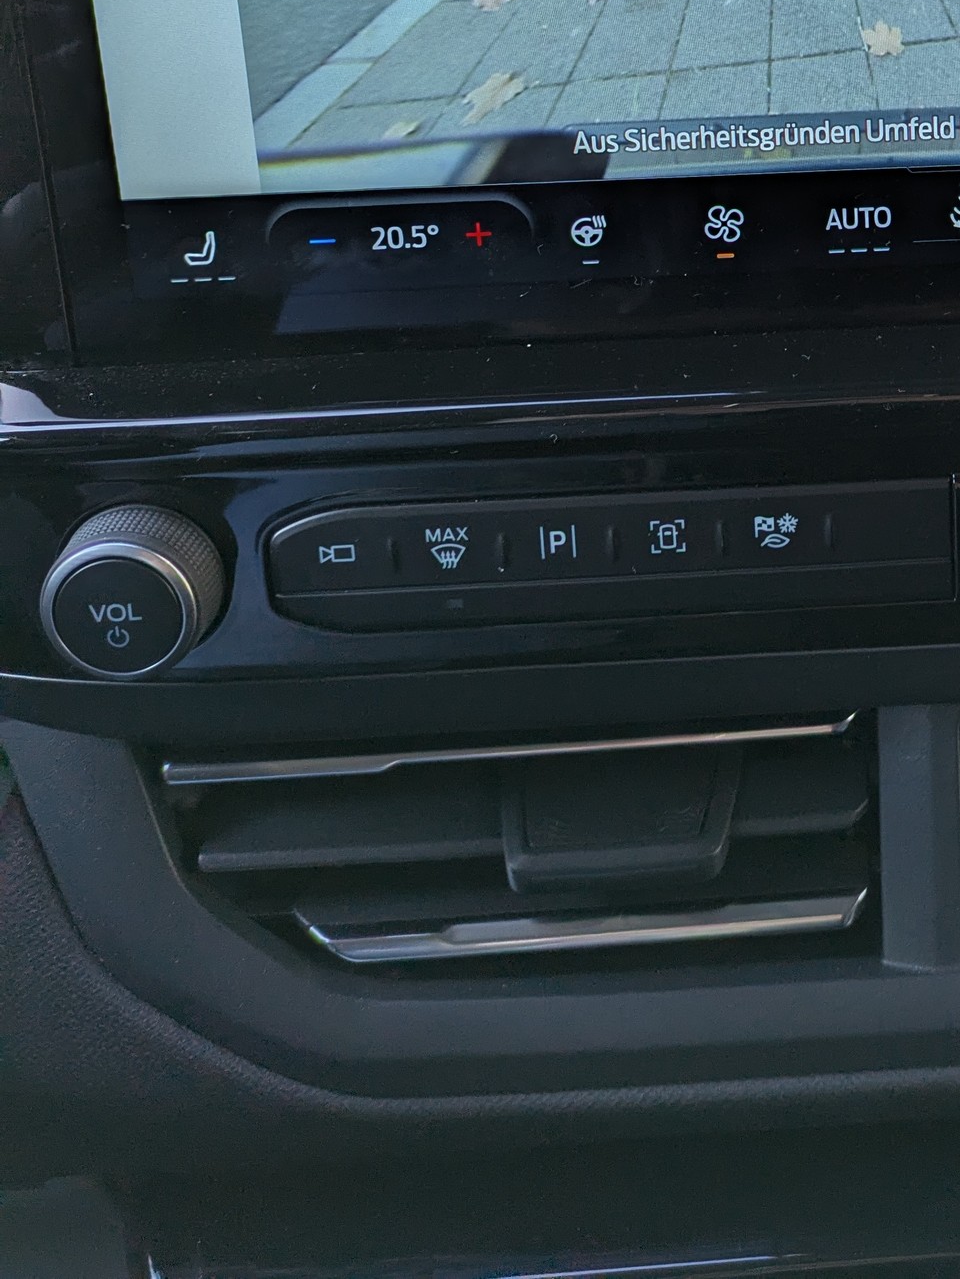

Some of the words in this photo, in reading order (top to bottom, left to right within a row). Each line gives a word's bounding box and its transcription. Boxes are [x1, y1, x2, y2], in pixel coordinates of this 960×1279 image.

[572, 130, 620, 155] Aus
[624, 118, 860, 152] Sicherheitsgründen
[866, 114, 955, 143] Umfeld
[825, 206, 892, 231] AUTO
[370, 224, 440, 251] 20.5°
[425, 526, 469, 543] MAX
[88, 602, 143, 624] VOL
